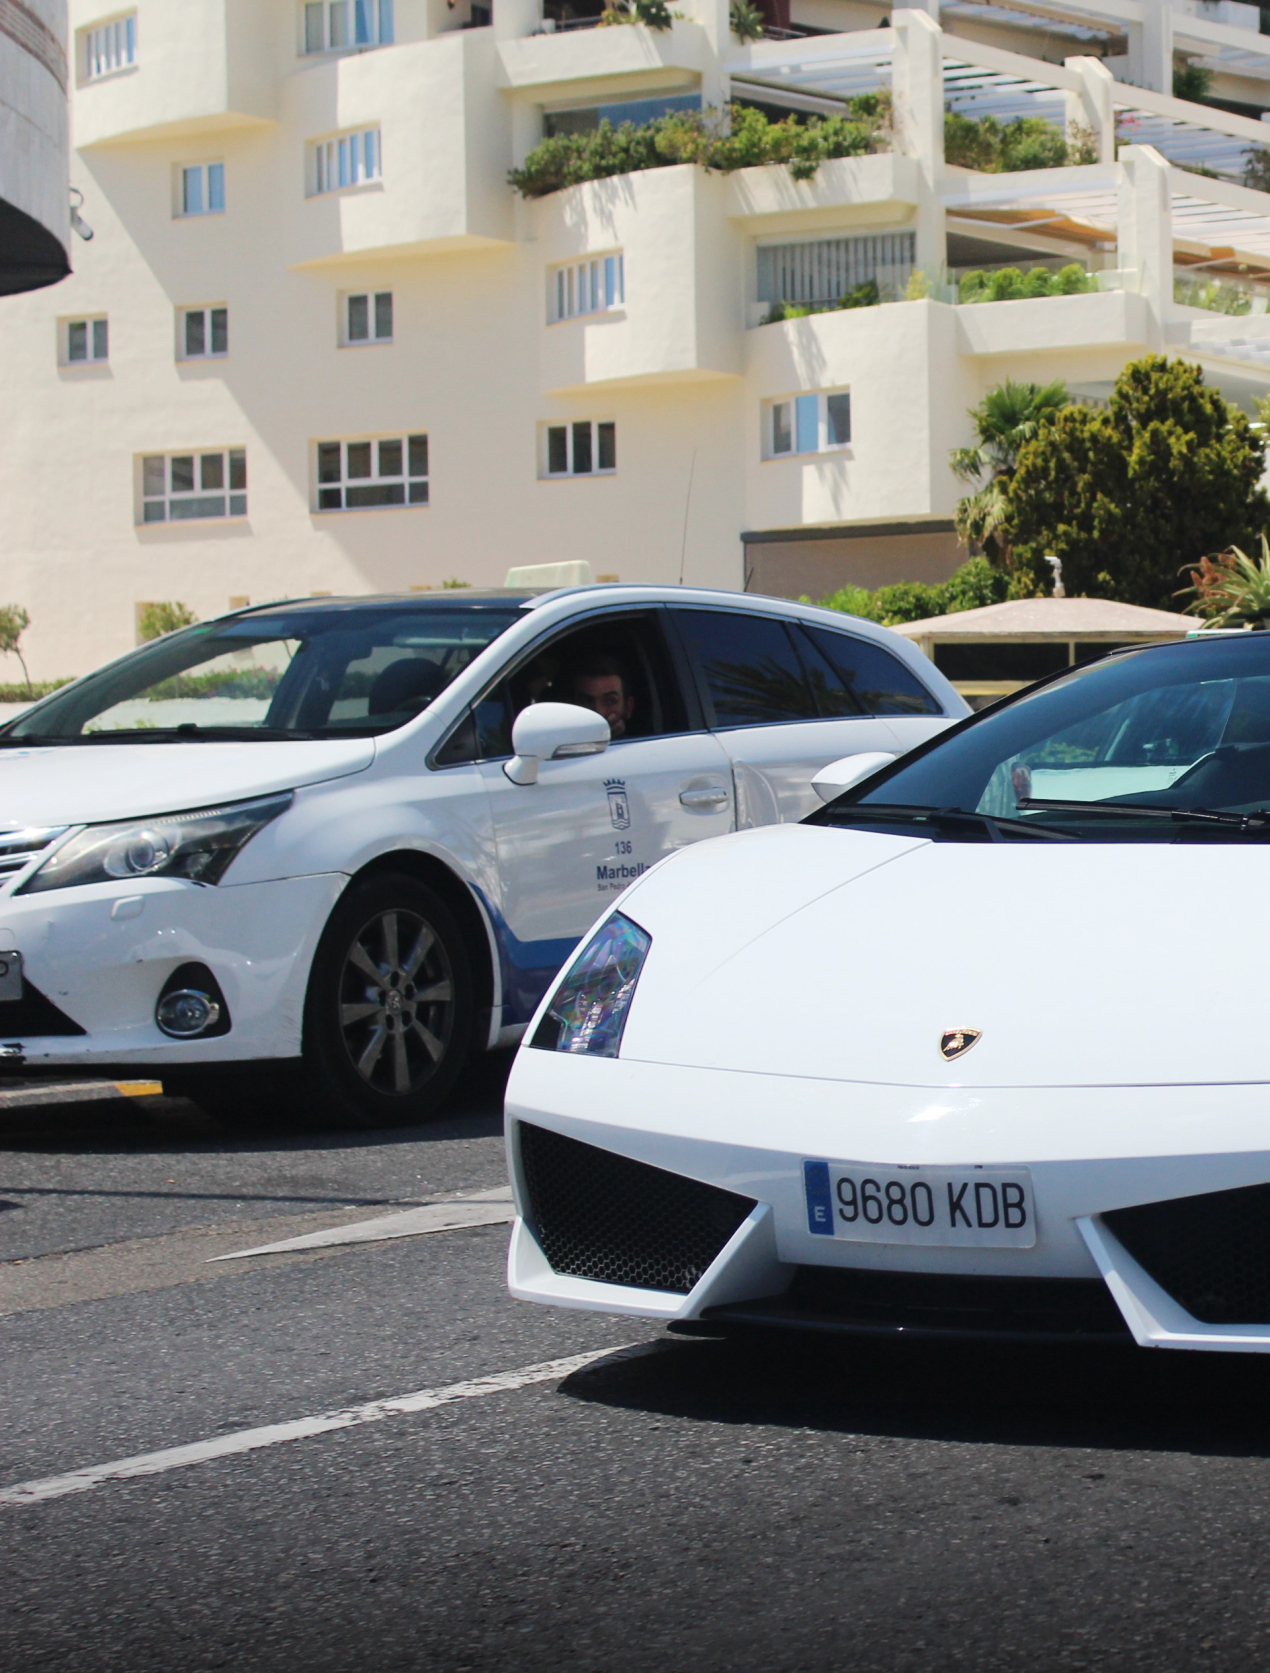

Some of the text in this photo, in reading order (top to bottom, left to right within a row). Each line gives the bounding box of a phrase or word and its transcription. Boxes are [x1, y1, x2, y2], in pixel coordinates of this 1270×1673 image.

[615, 841, 632, 855] 136
[836, 1177, 1027, 1228] 9680 KDB
[814, 1205, 827, 1222] E
